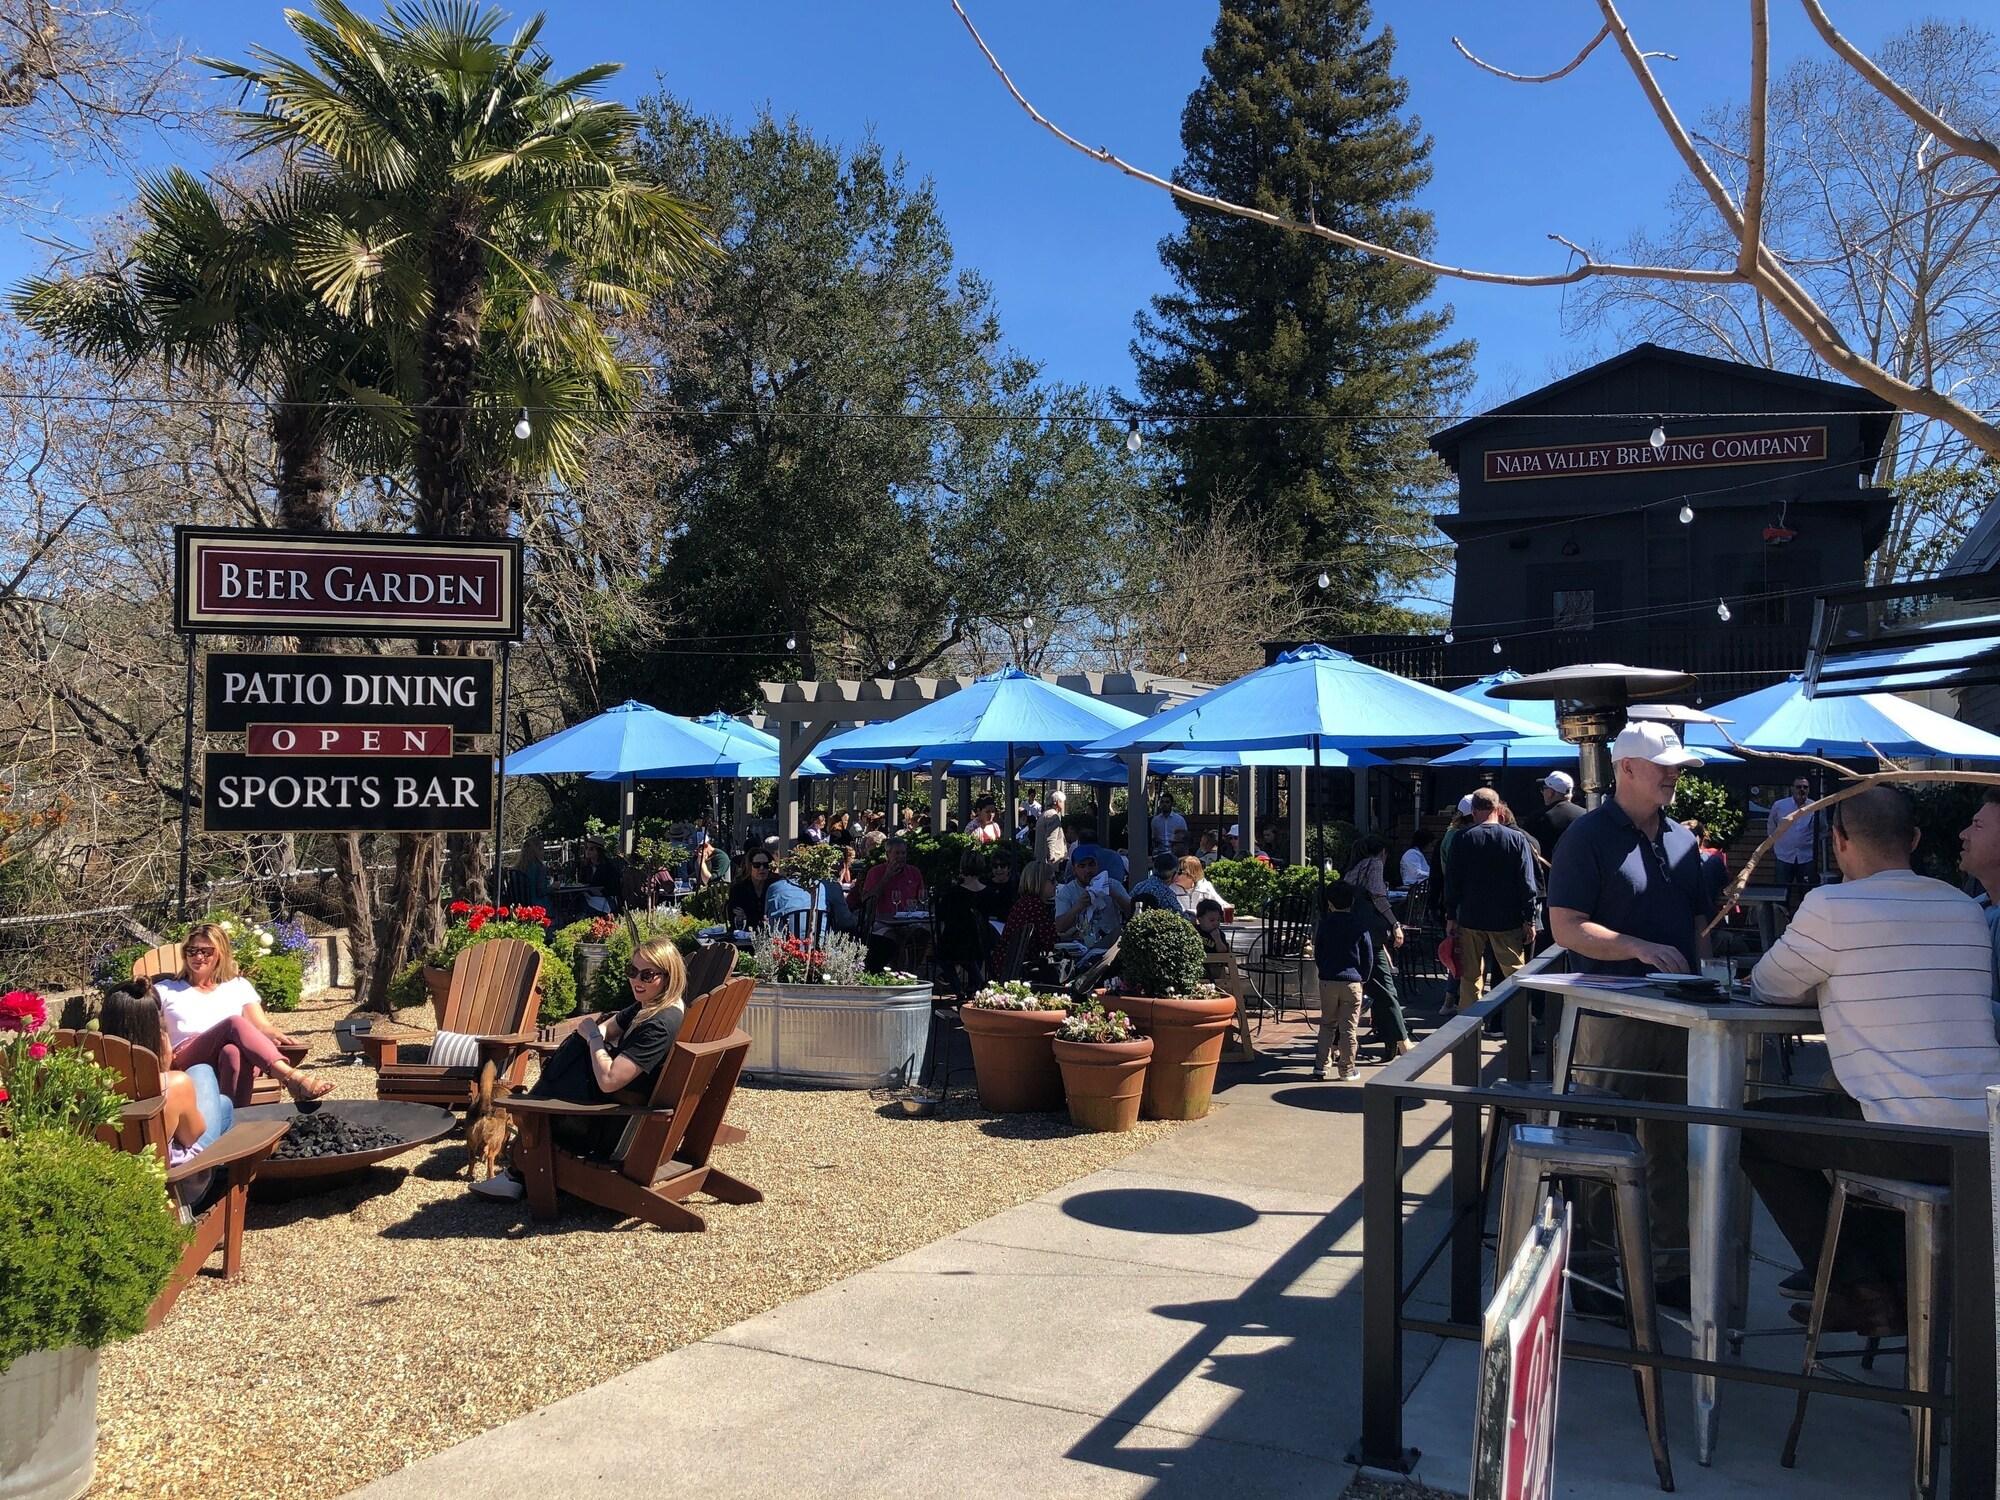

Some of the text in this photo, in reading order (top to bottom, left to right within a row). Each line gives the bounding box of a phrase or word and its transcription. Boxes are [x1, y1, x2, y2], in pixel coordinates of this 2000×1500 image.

[1496, 436, 1811, 473] NAPA VALLEY BREWING COMPANY
[218, 563, 484, 605] BEER GARDEN
[223, 672, 478, 707] PATIO DINING
[272, 729, 428, 751] OPEN
[218, 775, 480, 808] SPORTS BAR
